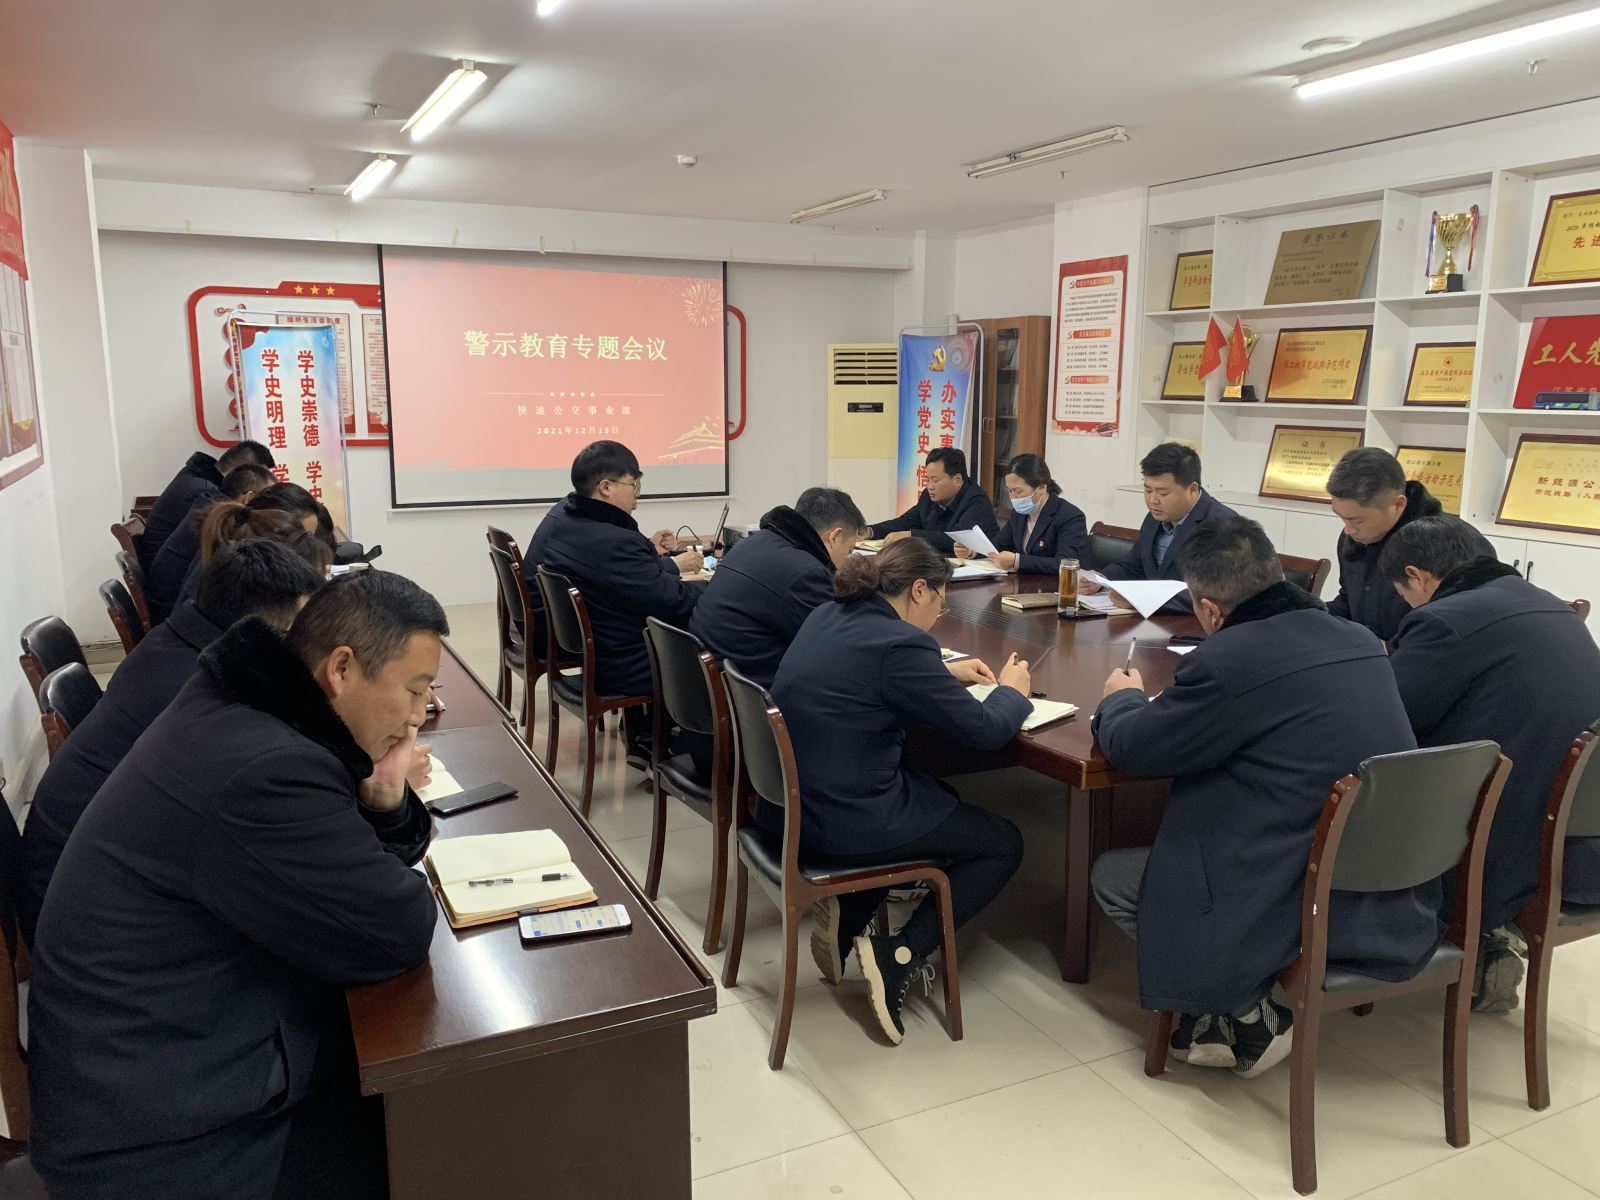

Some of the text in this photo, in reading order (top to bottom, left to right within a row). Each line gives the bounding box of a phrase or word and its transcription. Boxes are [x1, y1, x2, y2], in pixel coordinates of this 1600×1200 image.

[463, 329, 668, 361] 警示教育专题会议
[260, 348, 288, 450] 学史明理
[296, 349, 321, 448] 学史崇德
[516, 404, 632, 416] 快速公交事业部
[916, 378, 933, 455] 学党史
[939, 379, 957, 448] 办实事
[1537, 476, 1600, 488] 新能源公
